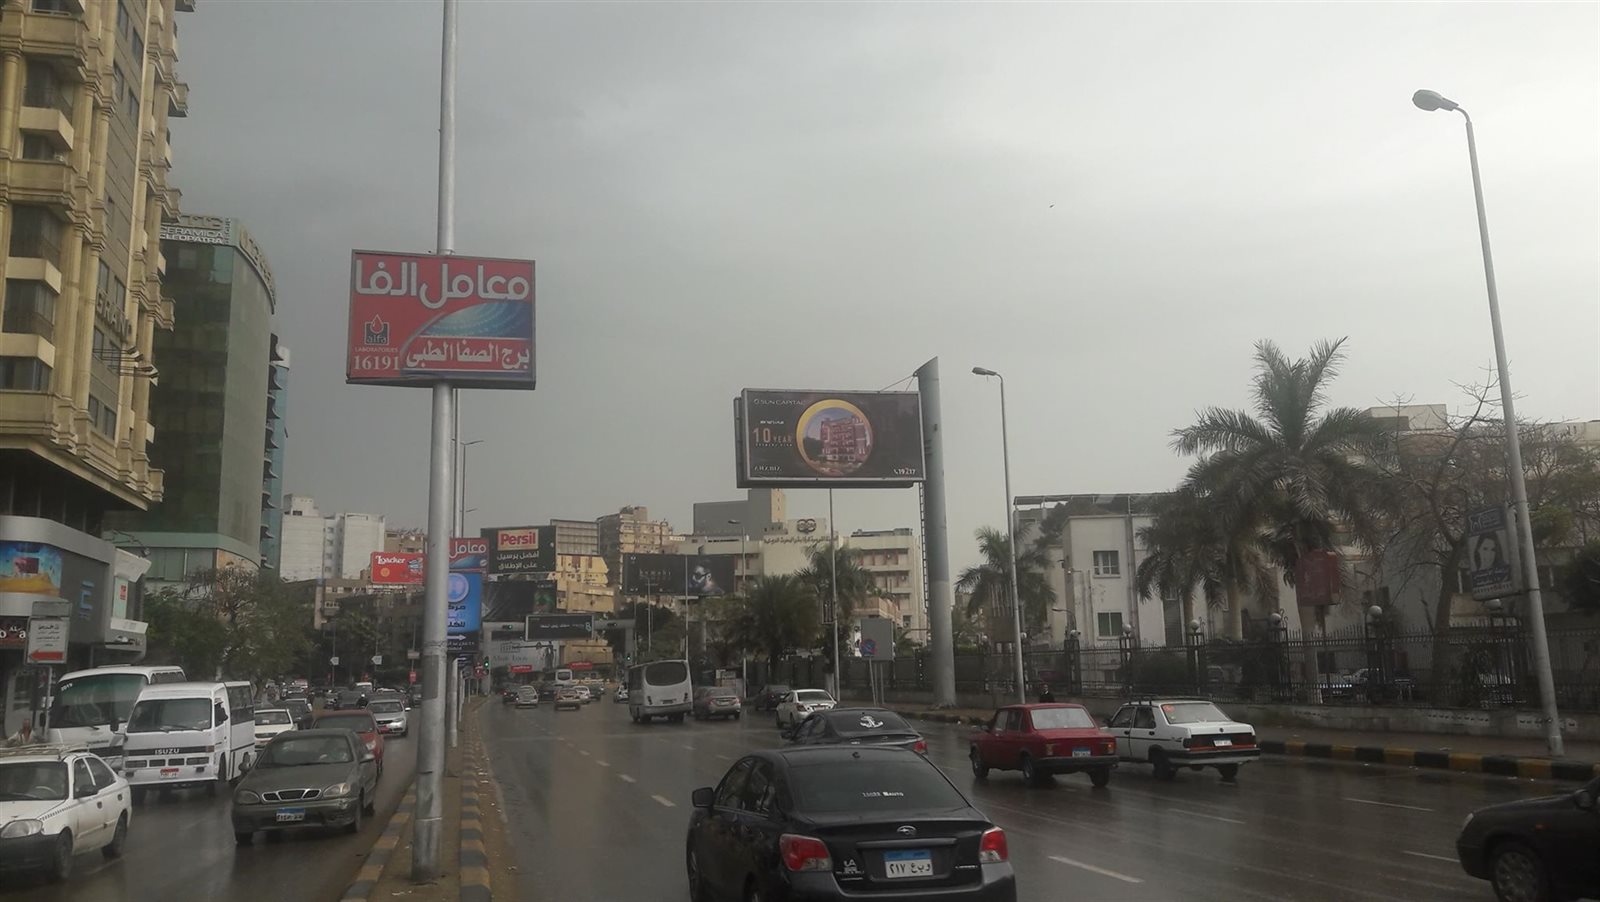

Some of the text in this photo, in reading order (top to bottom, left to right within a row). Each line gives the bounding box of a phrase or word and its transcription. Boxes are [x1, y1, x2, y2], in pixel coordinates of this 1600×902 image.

[159, 234, 223, 244] CLEOPATRA
[160, 226, 224, 238] CERAMICA
[355, 259, 530, 309] معامل الفا
[366, 333, 389, 344] alfa
[457, 339, 499, 363] الصفا
[501, 347, 530, 369] برج
[353, 355, 400, 370] 16191
[752, 427, 771, 443] 10
[500, 532, 536, 545] Persil
[889, 863, 907, 874] ٢١٧
